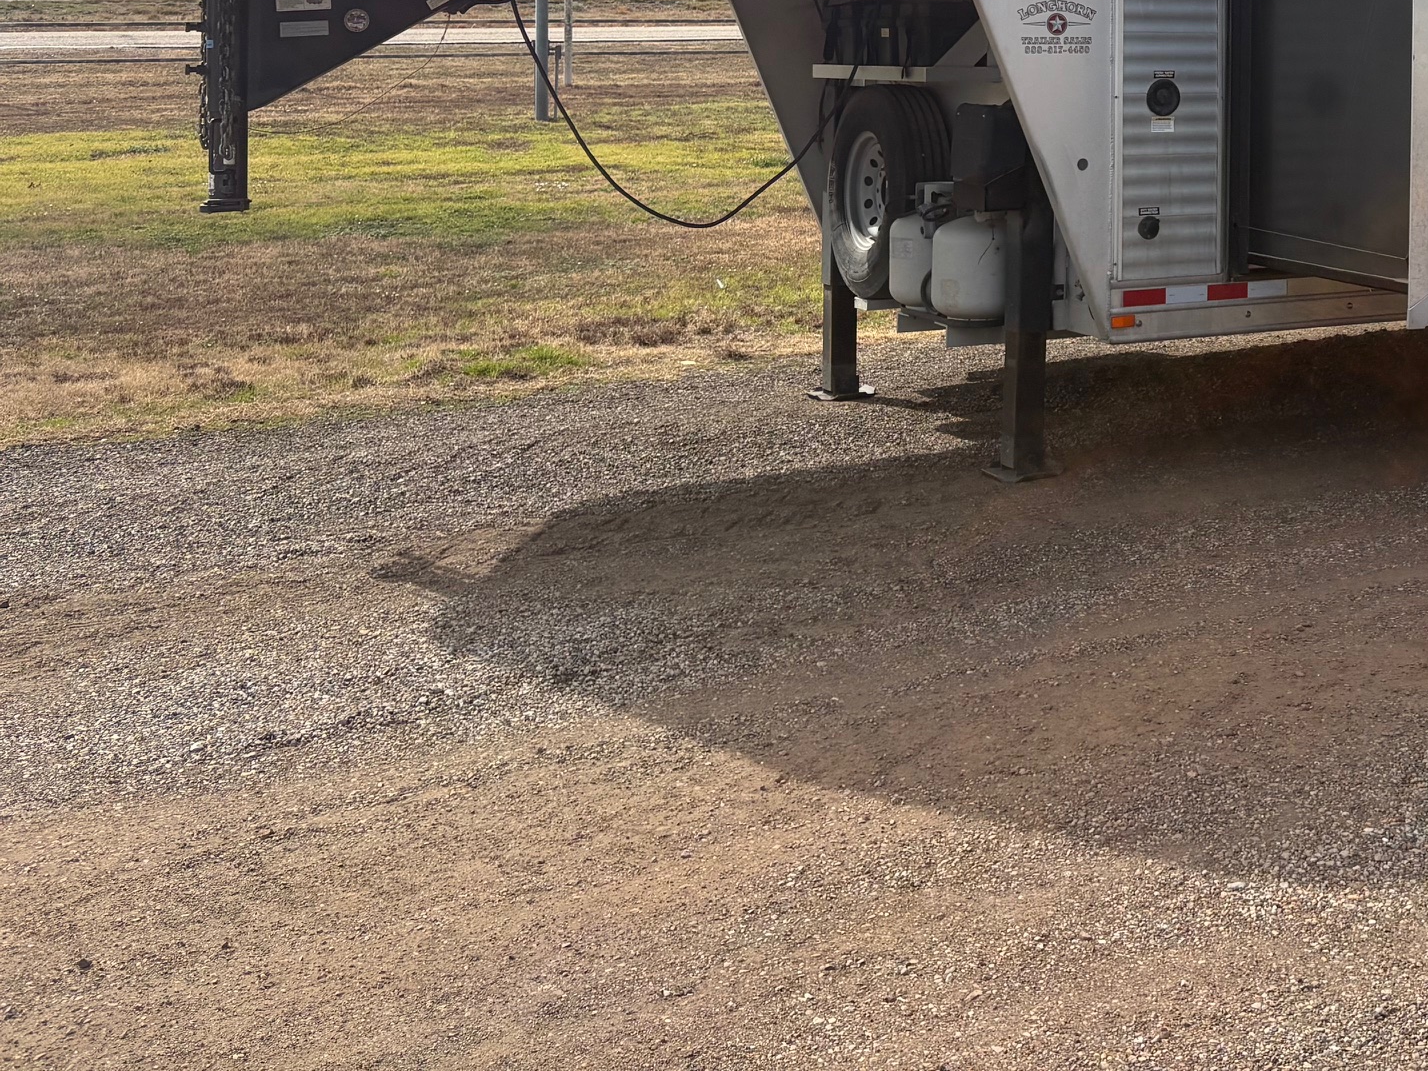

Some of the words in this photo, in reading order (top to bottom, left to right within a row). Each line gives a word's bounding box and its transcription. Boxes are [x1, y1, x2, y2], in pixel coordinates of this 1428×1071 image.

[1017, 0, 1098, 21] LONGHORN
[1020, 36, 1062, 45] TRAILER
[1063, 36, 1093, 45] SALES
